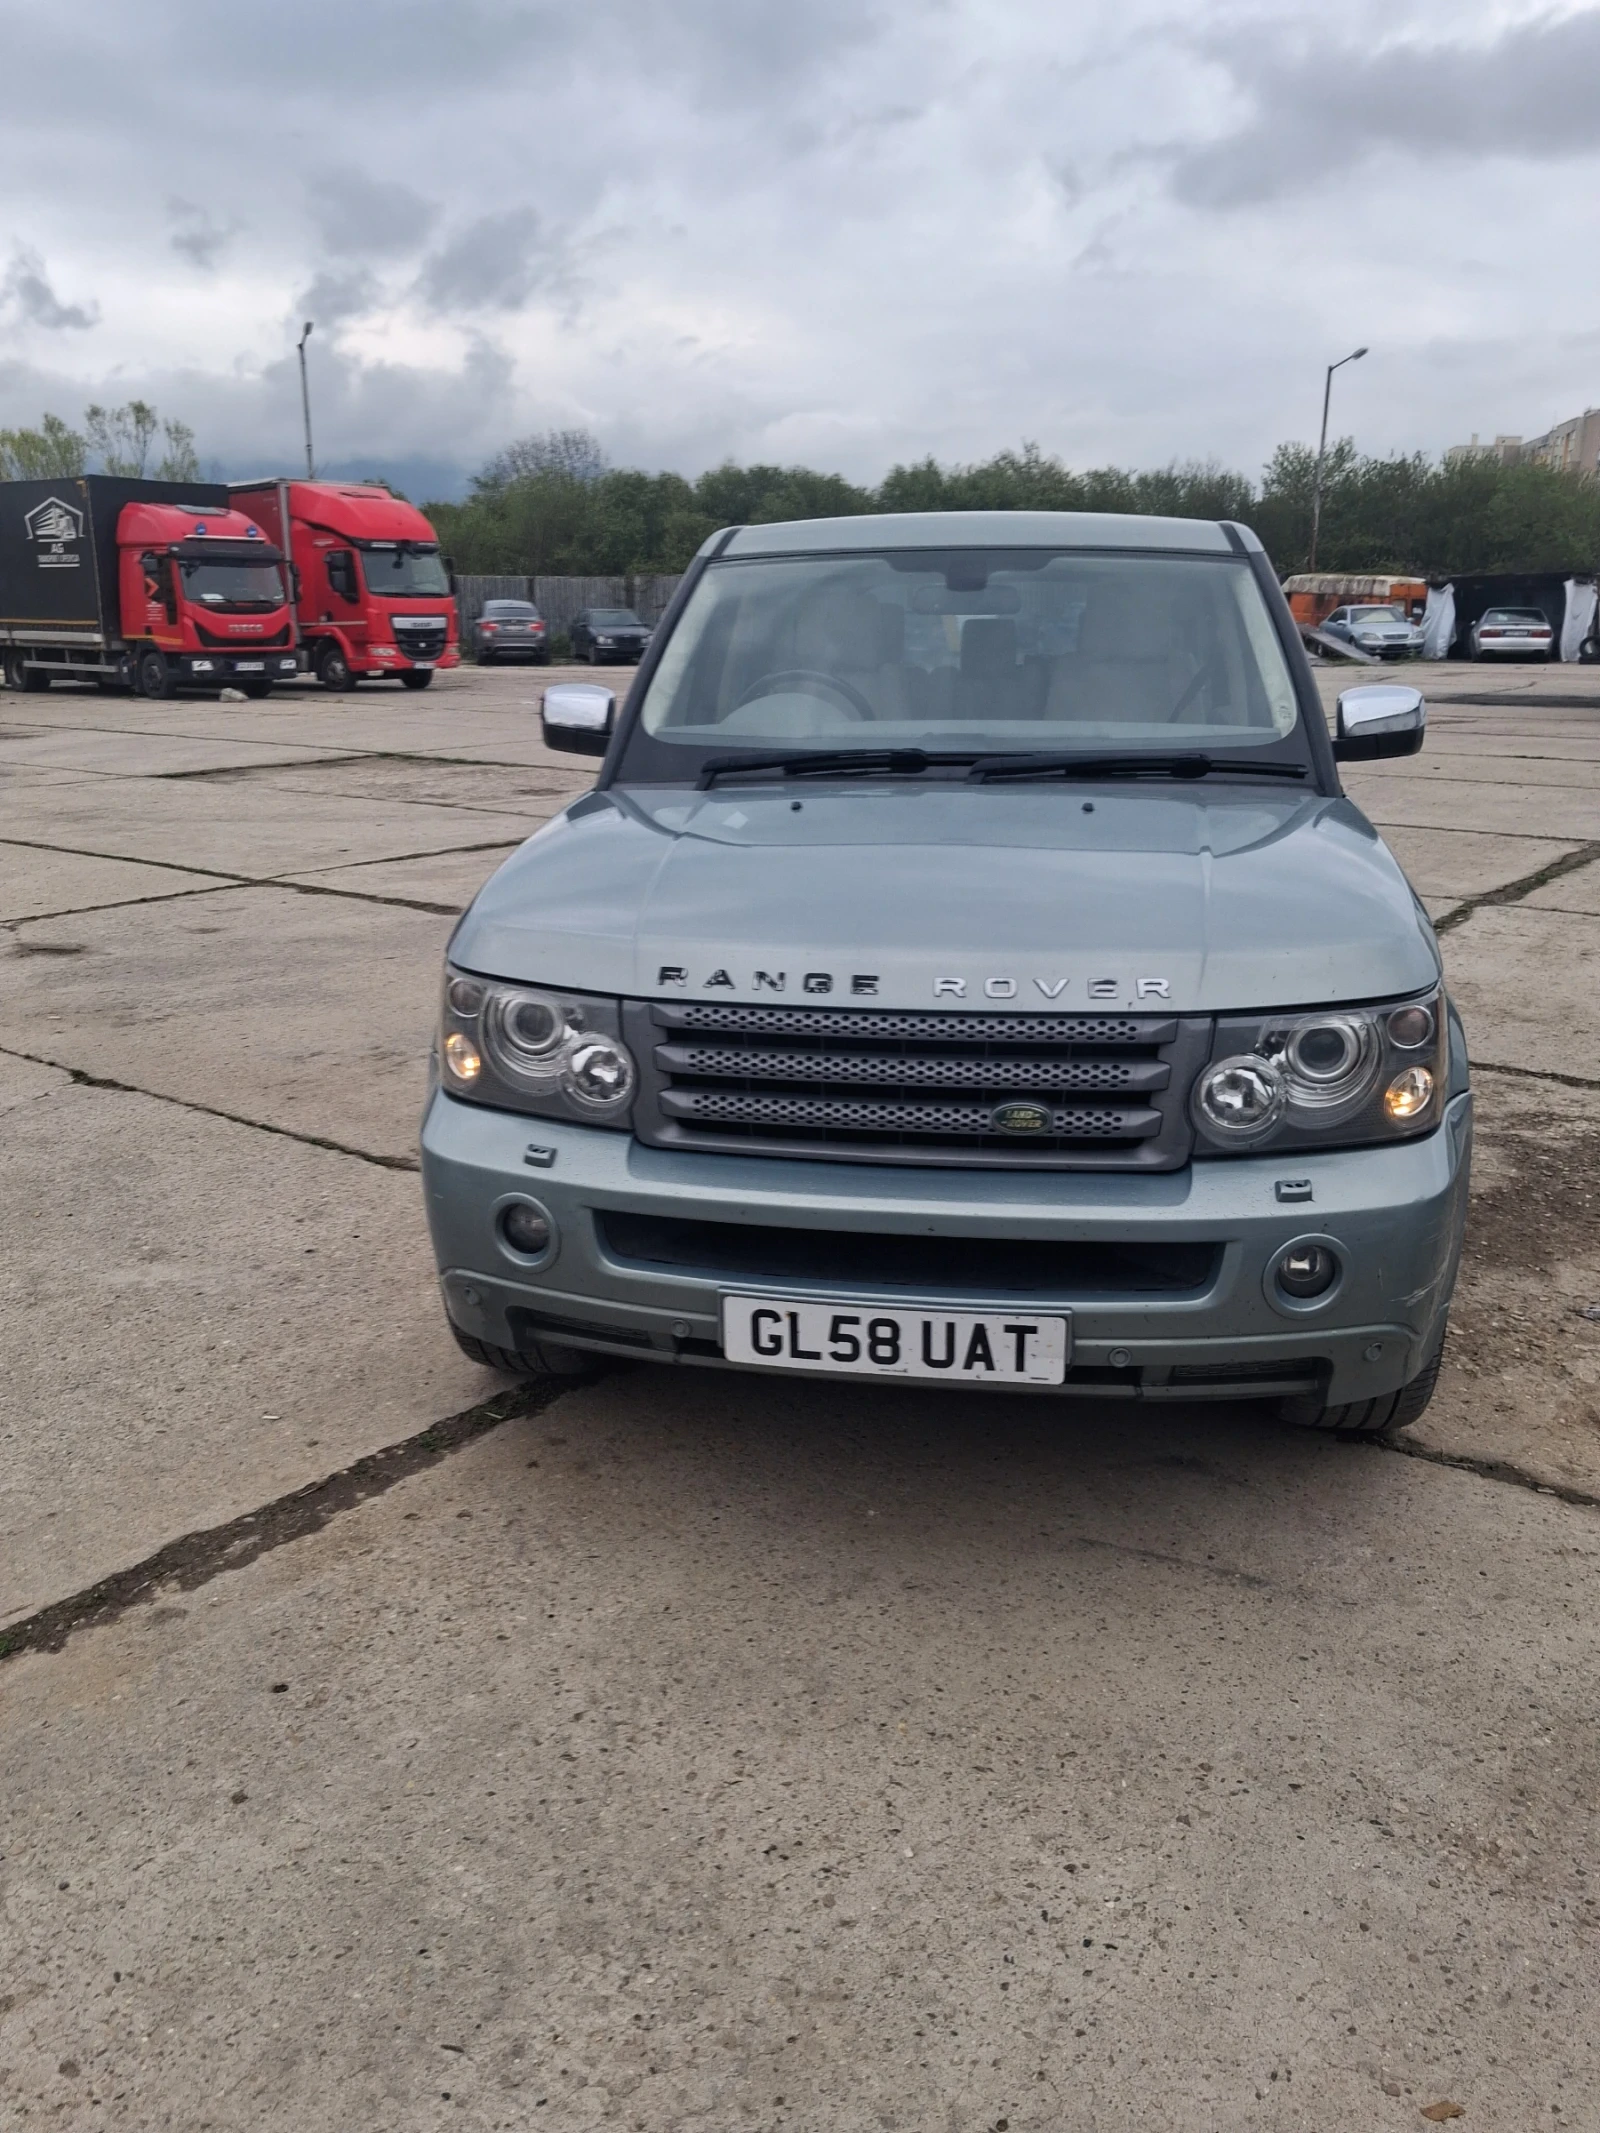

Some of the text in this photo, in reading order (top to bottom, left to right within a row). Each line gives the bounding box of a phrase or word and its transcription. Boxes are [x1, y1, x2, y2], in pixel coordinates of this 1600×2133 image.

[51, 543, 65, 554] AG
[656, 965, 1172, 999] RANGE ROVER
[751, 1308, 1038, 1373] GL58 UAT
